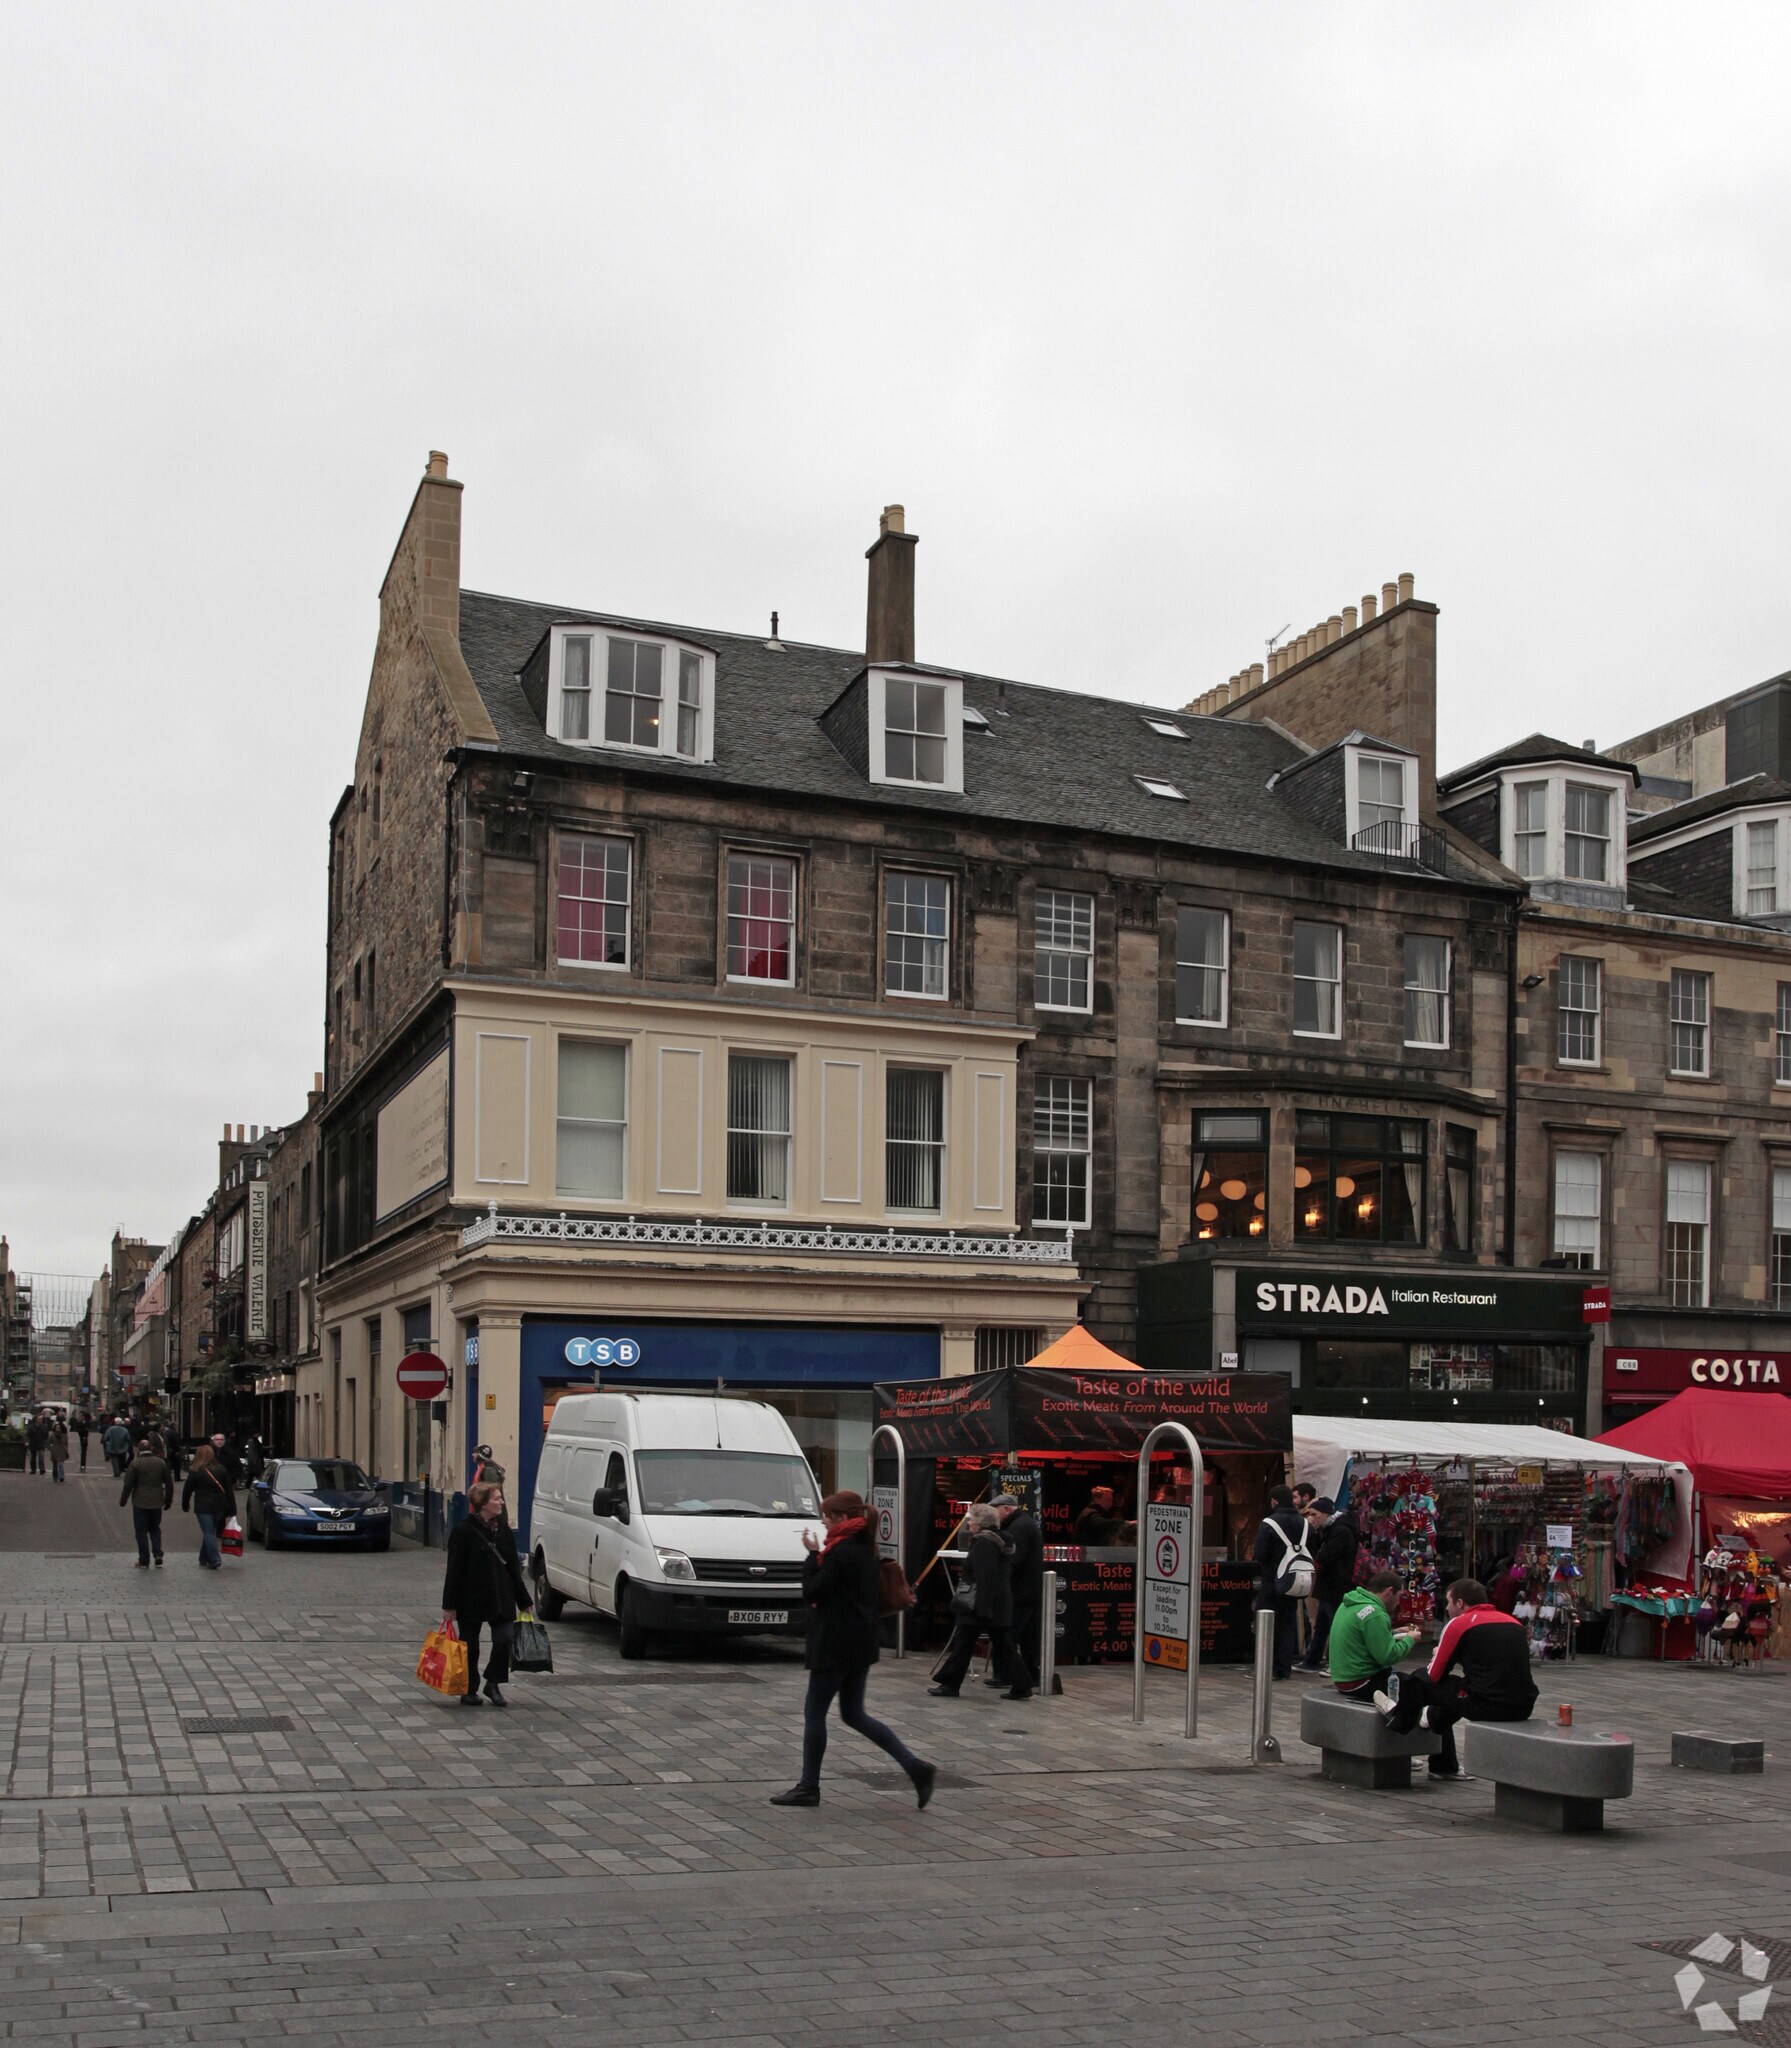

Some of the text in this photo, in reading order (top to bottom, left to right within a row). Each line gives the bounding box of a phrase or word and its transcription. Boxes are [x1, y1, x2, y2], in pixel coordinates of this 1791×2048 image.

[252, 1190, 264, 1331] PATISSERIE VALERIE
[1256, 1282, 1390, 1315] STRADA
[1391, 1289, 1497, 1305] Italian Restaurant
[1583, 1301, 1607, 1310] STRADA
[573, 1342, 634, 1362] TSB
[1690, 1358, 1780, 1386] COSTA
[1071, 1376, 1231, 1396] Taste of the wild
[896, 1381, 974, 1405] Taste of the wild
[913, 1405, 929, 1417] From
[929, 1403, 954, 1416] Around
[955, 1401, 969, 1414] The
[970, 1398, 991, 1412] World
[1042, 1399, 1269, 1414] Exotic Meats From Around The World
[1000, 1474, 1032, 1483] SPECIALS
[1001, 1481, 1027, 1495] BEAST
[877, 1497, 894, 1508] ZONE
[1150, 1507, 1188, 1519] PEDESTRIAN
[1154, 1518, 1182, 1534] ZONE
[1094, 1563, 1132, 1578] Taste
[1200, 1563, 1219, 1578] ild
[1072, 1580, 1100, 1591] Exotic
[1103, 1580, 1132, 1591] Meats
[1152, 1583, 1181, 1595] Except for
[1201, 1580, 1219, 1590] The
[1220, 1580, 1250, 1591] World
[1156, 1594, 1177, 1607] loading
[733, 1611, 784, 1622] BX06 RYY
[1154, 1604, 1178, 1616] 11.00pm
[1163, 1615, 1170, 1624] to
[1153, 1622, 1178, 1635] 10.30am
[1093, 1640, 1128, 1652] £4.00
[1165, 1643, 1173, 1651] At
[1167, 1654, 1180, 1664] time
